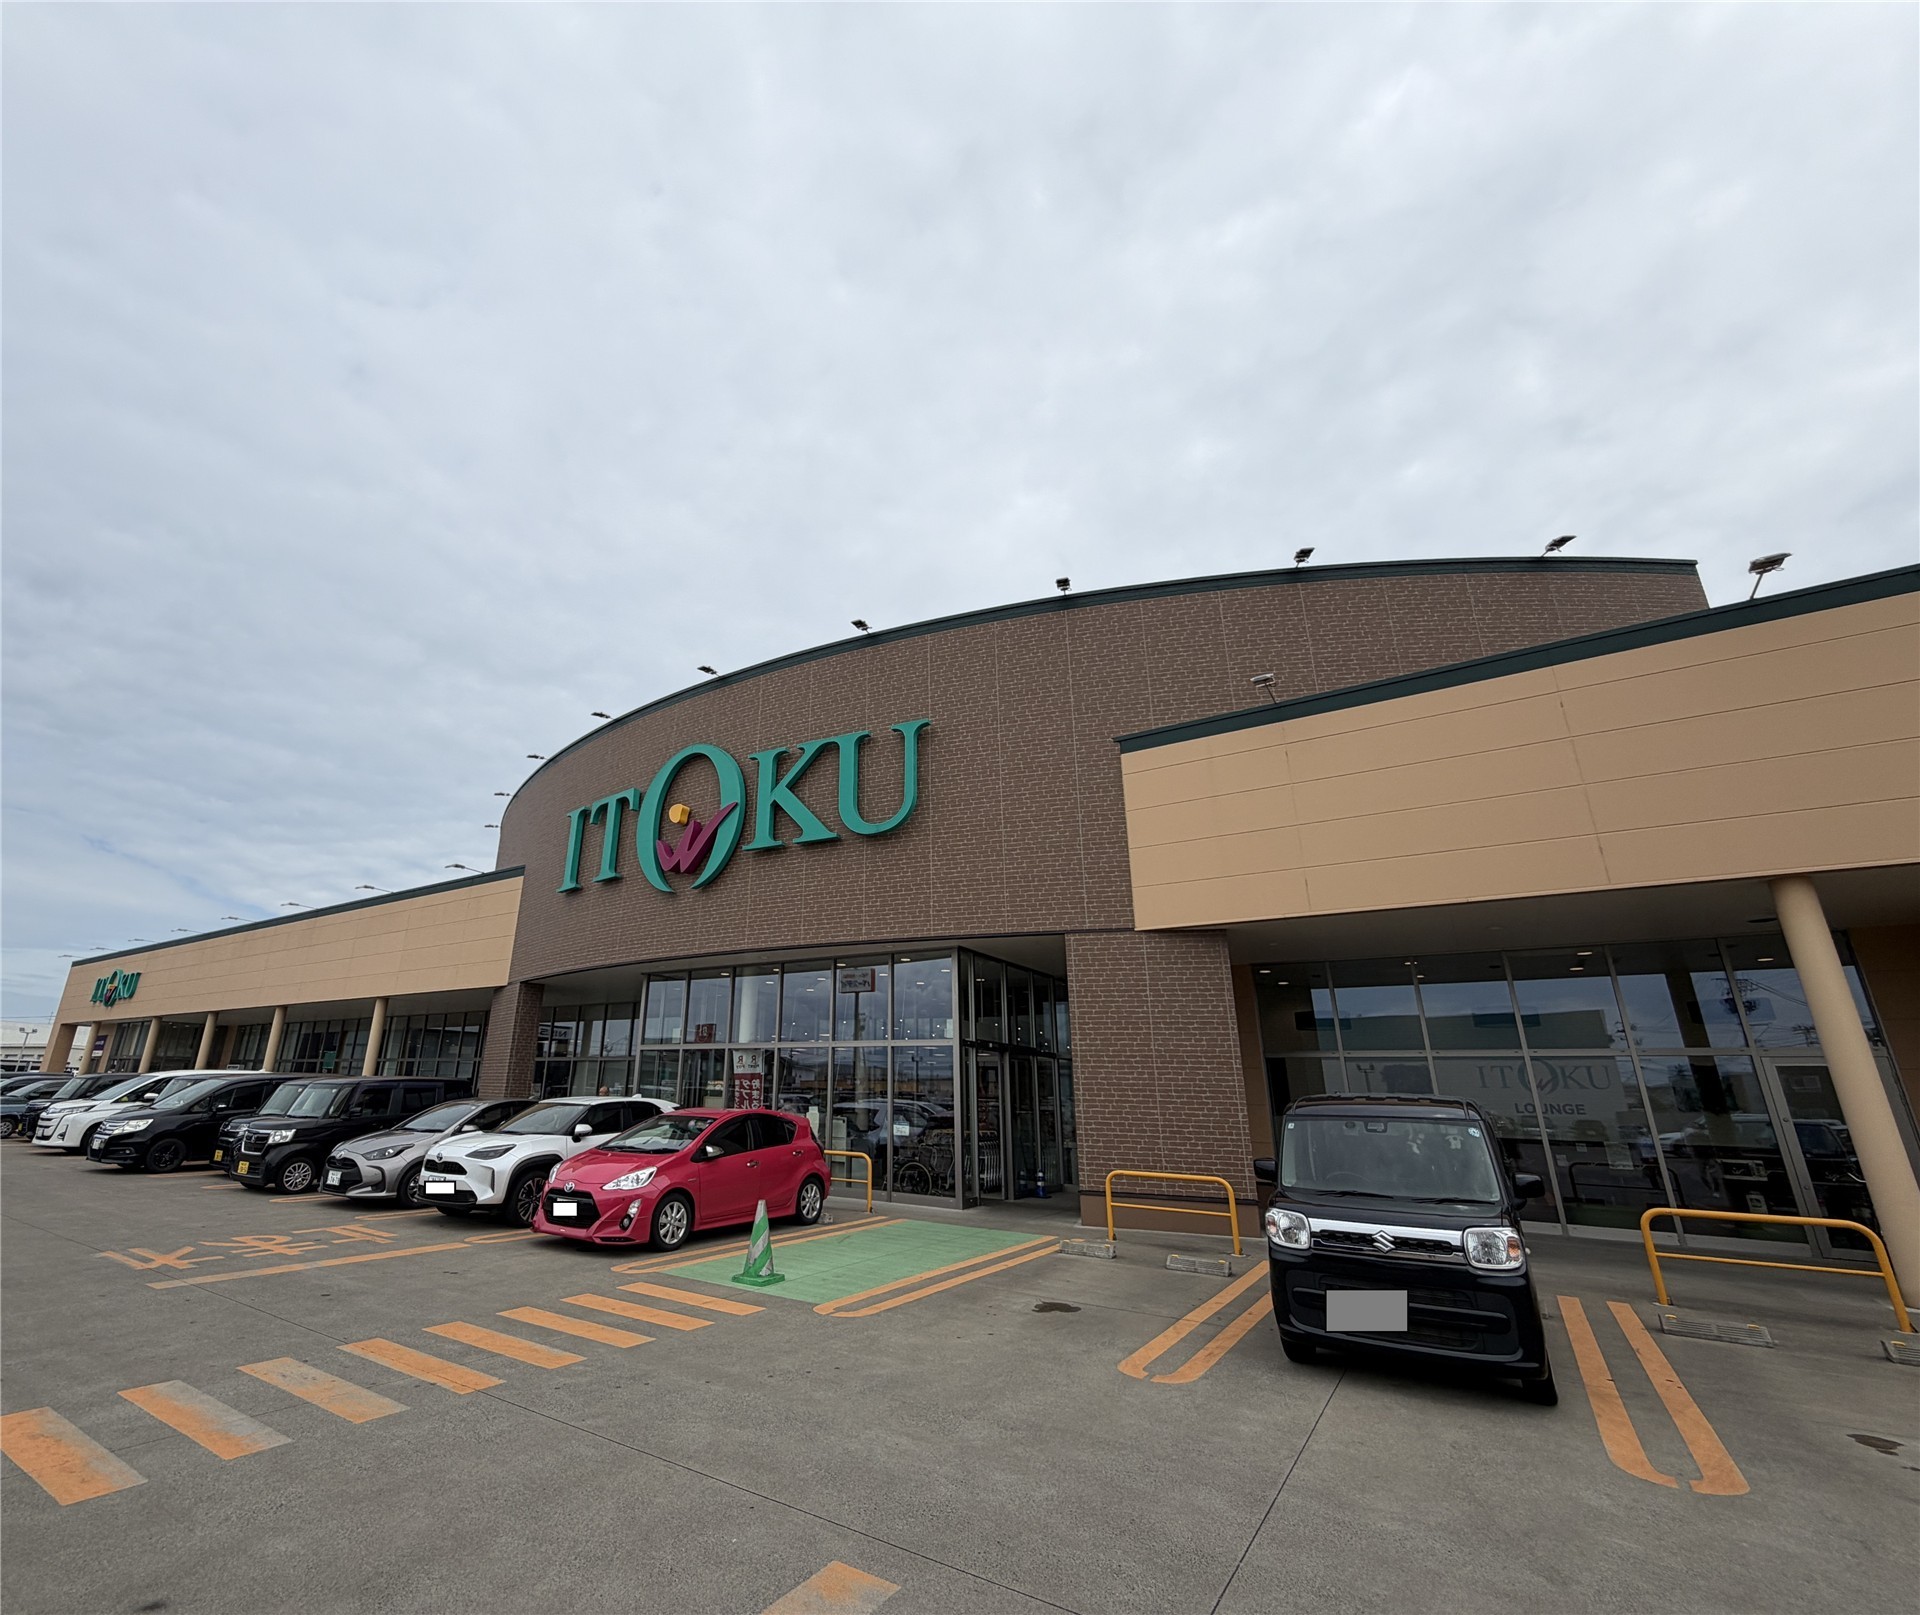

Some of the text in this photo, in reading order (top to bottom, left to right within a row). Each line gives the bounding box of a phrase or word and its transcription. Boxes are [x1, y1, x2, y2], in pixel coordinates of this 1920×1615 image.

[556, 718, 932, 893] ITOKU
[90, 969, 142, 1007] ITOKU
[1475, 1058, 1612, 1096] ITOKU
[1514, 1103, 1587, 1115] LOUNGE
